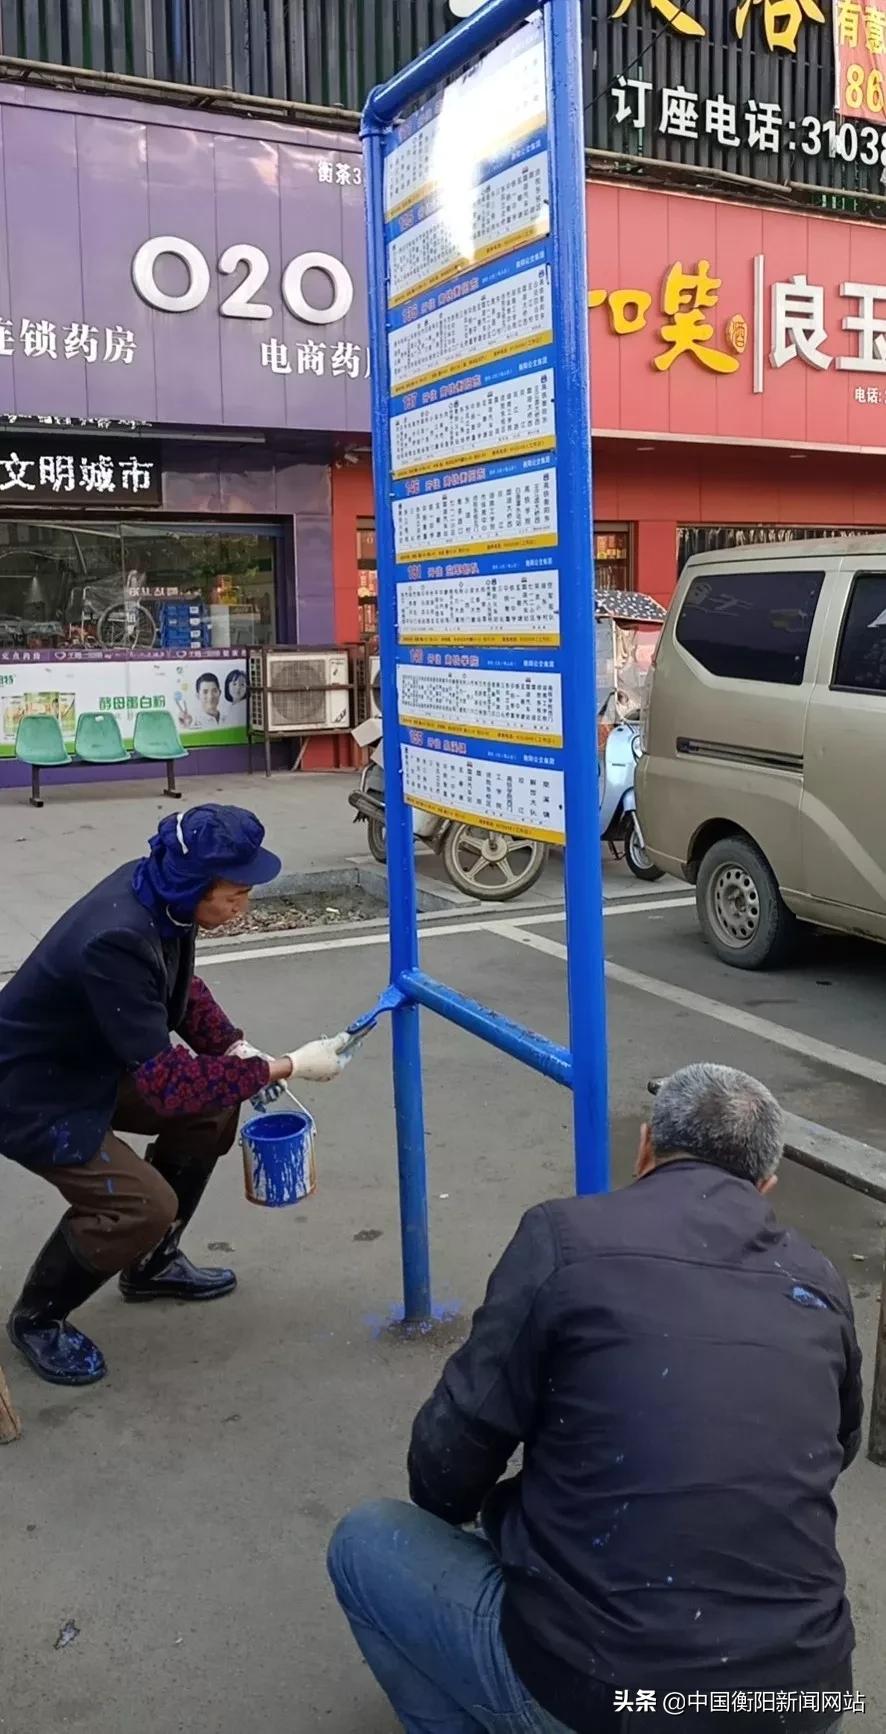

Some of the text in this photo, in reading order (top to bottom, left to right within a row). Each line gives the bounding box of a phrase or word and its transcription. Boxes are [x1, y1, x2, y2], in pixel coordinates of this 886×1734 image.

[611, 75, 886, 166] 订座电话:3103
[588, 260, 740, 374] 口笑
[769, 275, 886, 372] 良玉
[261, 337, 371, 379] 电商药
[855, 387, 886, 405] 电话:
[0, 452, 154, 492] 文明城市
